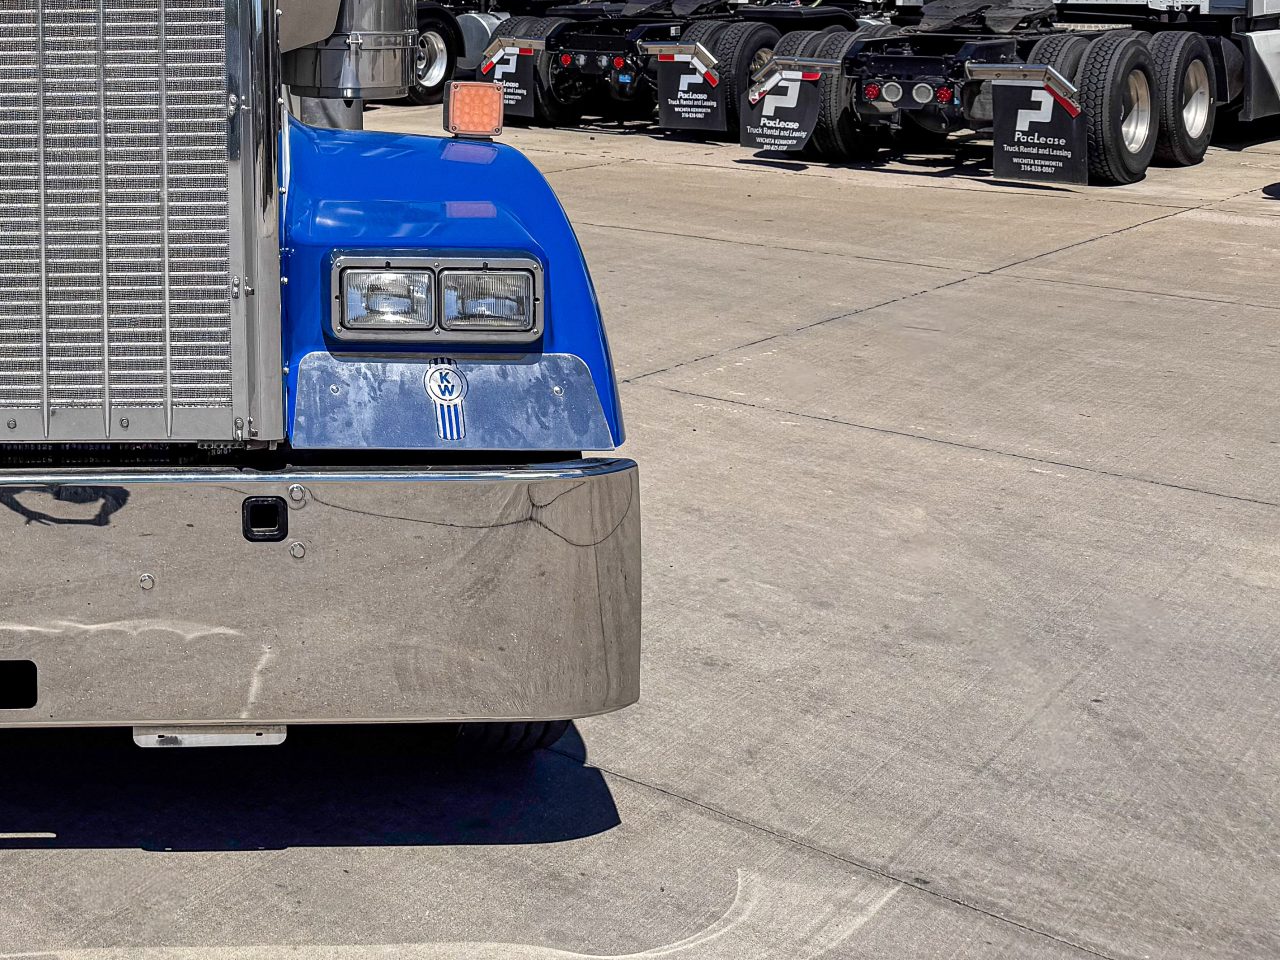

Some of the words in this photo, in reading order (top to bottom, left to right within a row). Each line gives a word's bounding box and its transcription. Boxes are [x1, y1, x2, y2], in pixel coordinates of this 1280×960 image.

[677, 91, 708, 100] PacLease
[760, 117, 800, 129] PacLease
[746, 126, 763, 135] Truck
[763, 127, 780, 136] Rental
[780, 128, 790, 137] and
[1014, 131, 1066, 145] PacLease
[1002, 144, 1019, 152] Truck
[1019, 145, 1038, 154] Rental
[1038, 147, 1050, 155] and
[1049, 148, 1072, 159] Leasing
[1012, 157, 1035, 165] WICHITA
[1034, 159, 1063, 167] KENWORTH
[439, 371, 452, 384] K
[437, 384, 455, 397] W
